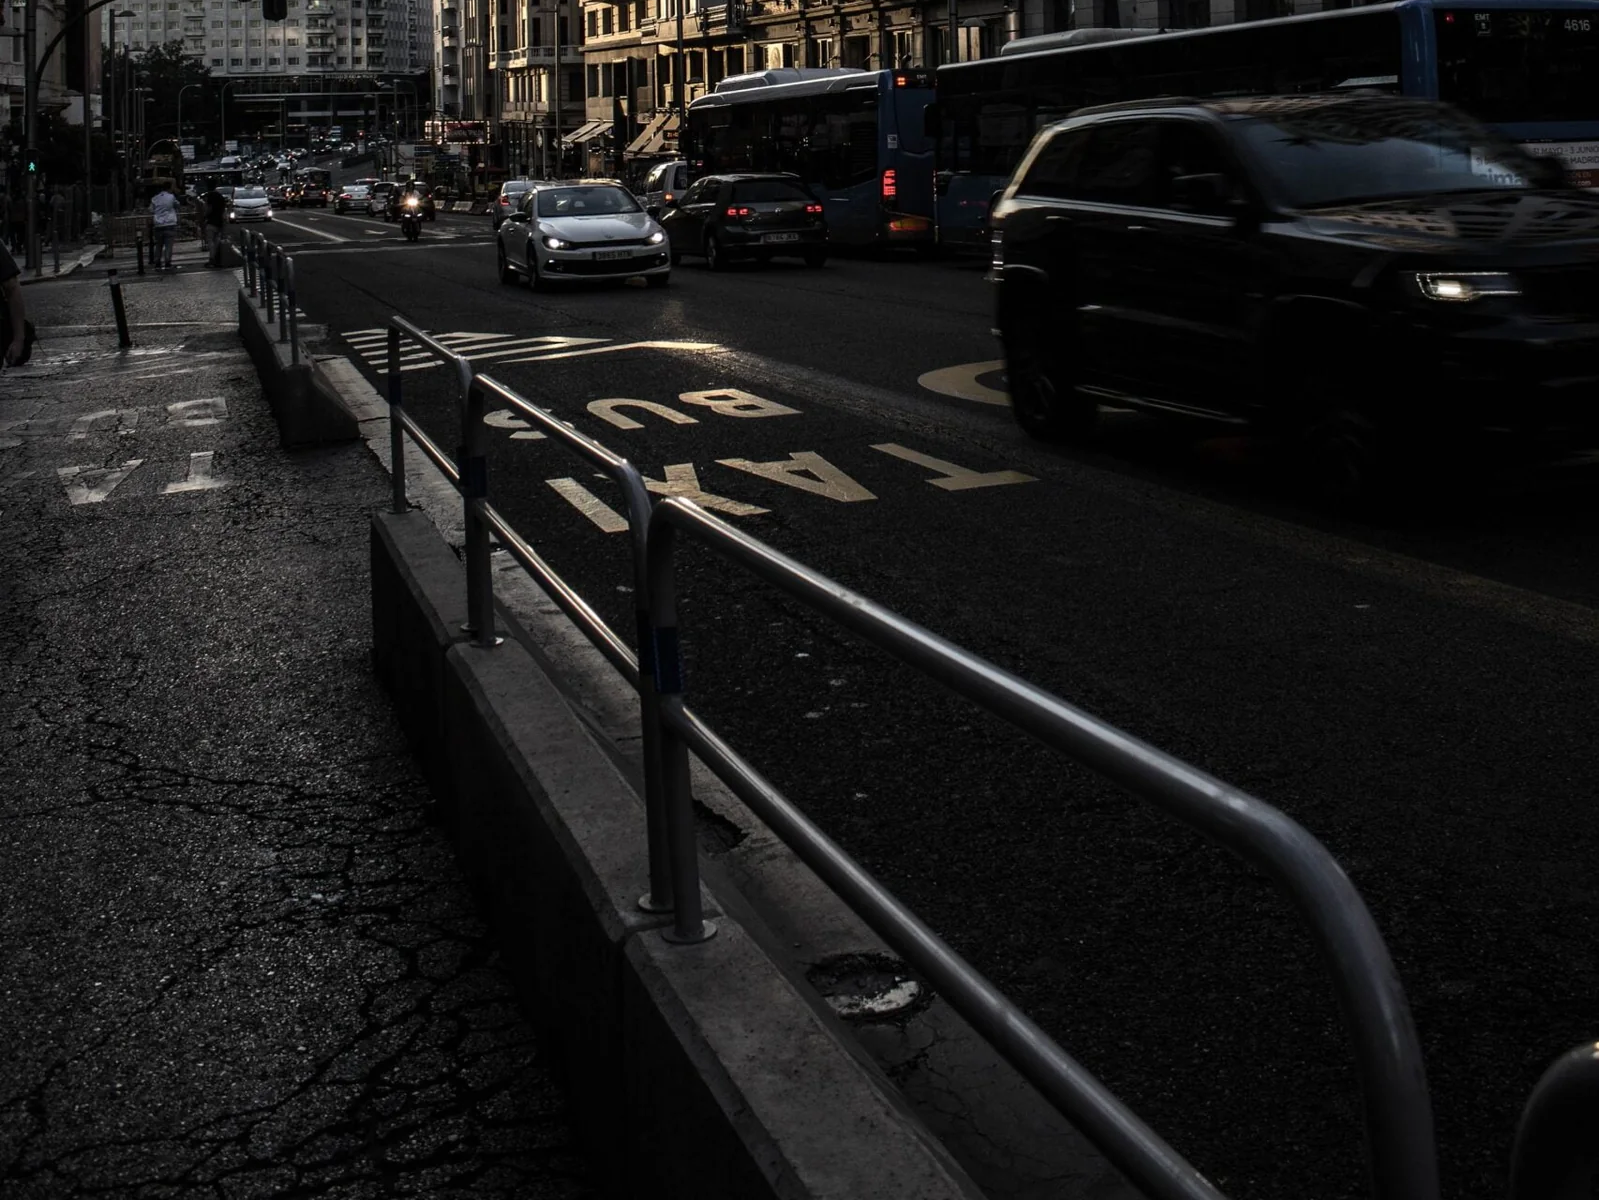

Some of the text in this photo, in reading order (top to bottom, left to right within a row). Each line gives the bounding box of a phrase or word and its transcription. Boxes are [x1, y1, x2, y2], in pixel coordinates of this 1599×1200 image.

[1474, 13, 1490, 21] EMT
[1563, 19, 1592, 32] 4616
[481, 387, 804, 440] BUS
[544, 443, 1041, 535] TAXI
